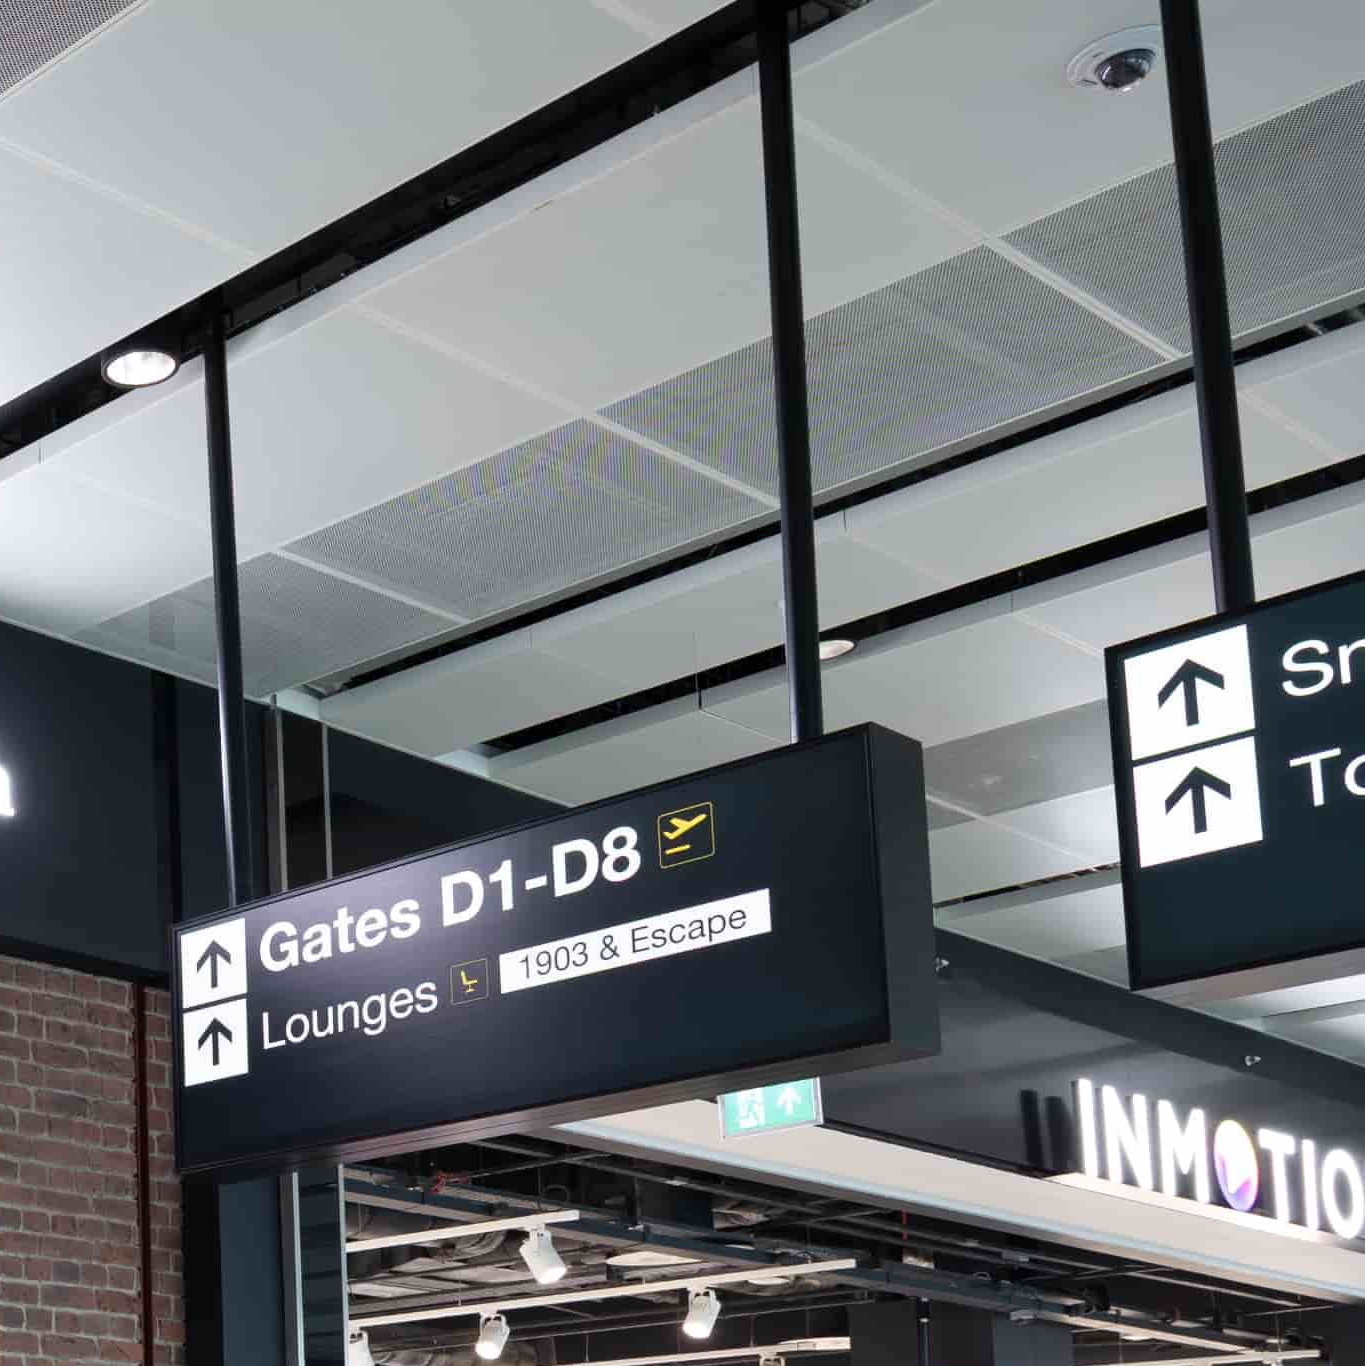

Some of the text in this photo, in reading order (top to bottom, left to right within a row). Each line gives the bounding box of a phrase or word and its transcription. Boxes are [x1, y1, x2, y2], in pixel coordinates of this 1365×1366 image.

[259, 826, 641, 972] Gates D1-D8
[518, 905, 747, 980] 1903 & Escape
[262, 980, 438, 1050] Lounges
